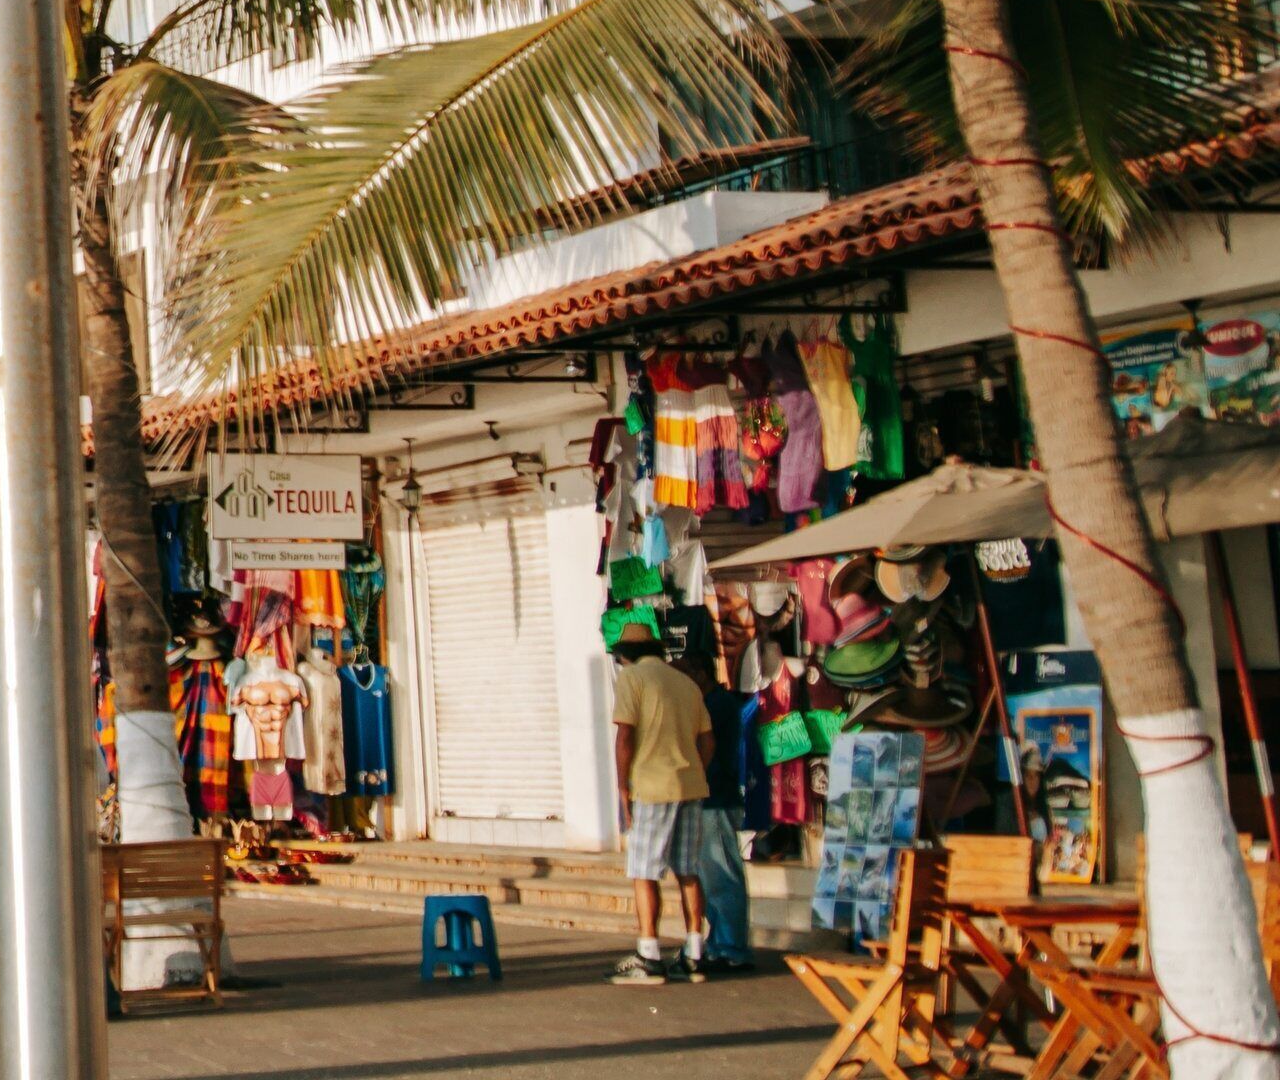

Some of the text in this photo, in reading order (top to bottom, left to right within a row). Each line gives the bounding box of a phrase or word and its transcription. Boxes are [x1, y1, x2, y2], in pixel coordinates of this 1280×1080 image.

[269, 470, 291, 481] Casa
[273, 489, 356, 515] TEQUILA
[234, 551, 249, 561] No
[252, 551, 277, 561] Time
[280, 551, 315, 561] Shares
